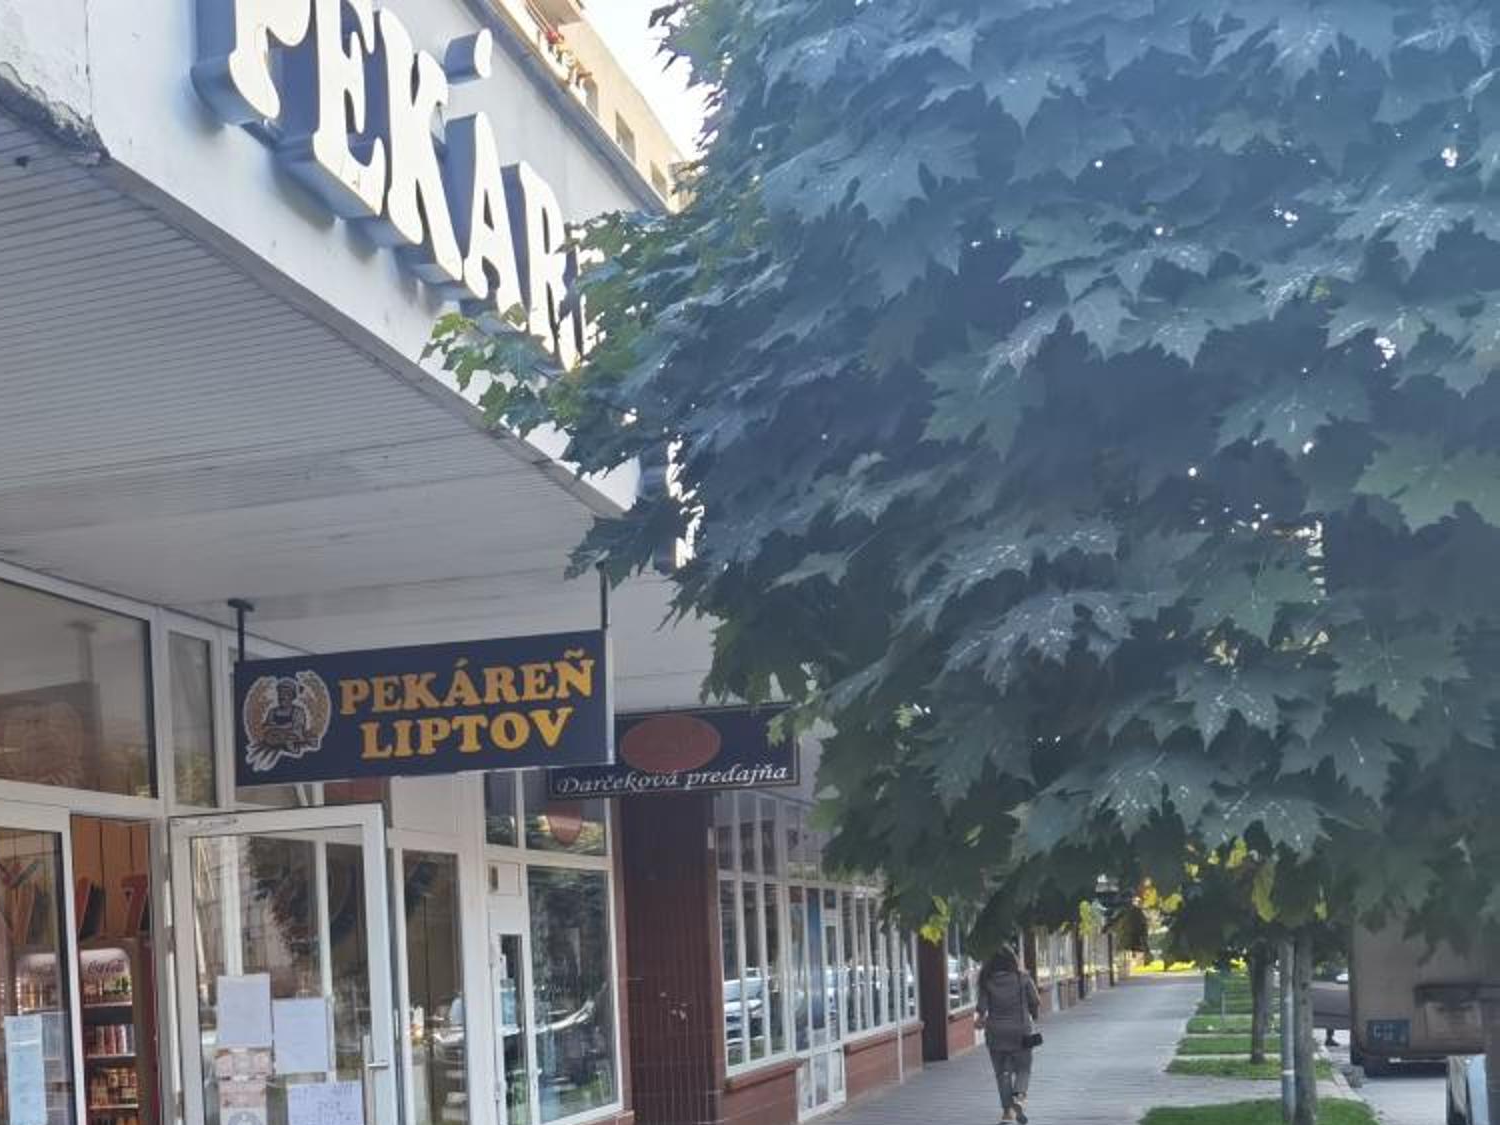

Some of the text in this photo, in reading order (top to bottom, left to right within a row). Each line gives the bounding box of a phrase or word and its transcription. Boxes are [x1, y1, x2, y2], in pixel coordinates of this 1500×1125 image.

[359, 706, 574, 760] LIPTOV
[556, 762, 788, 793] Darčeková predajňa
